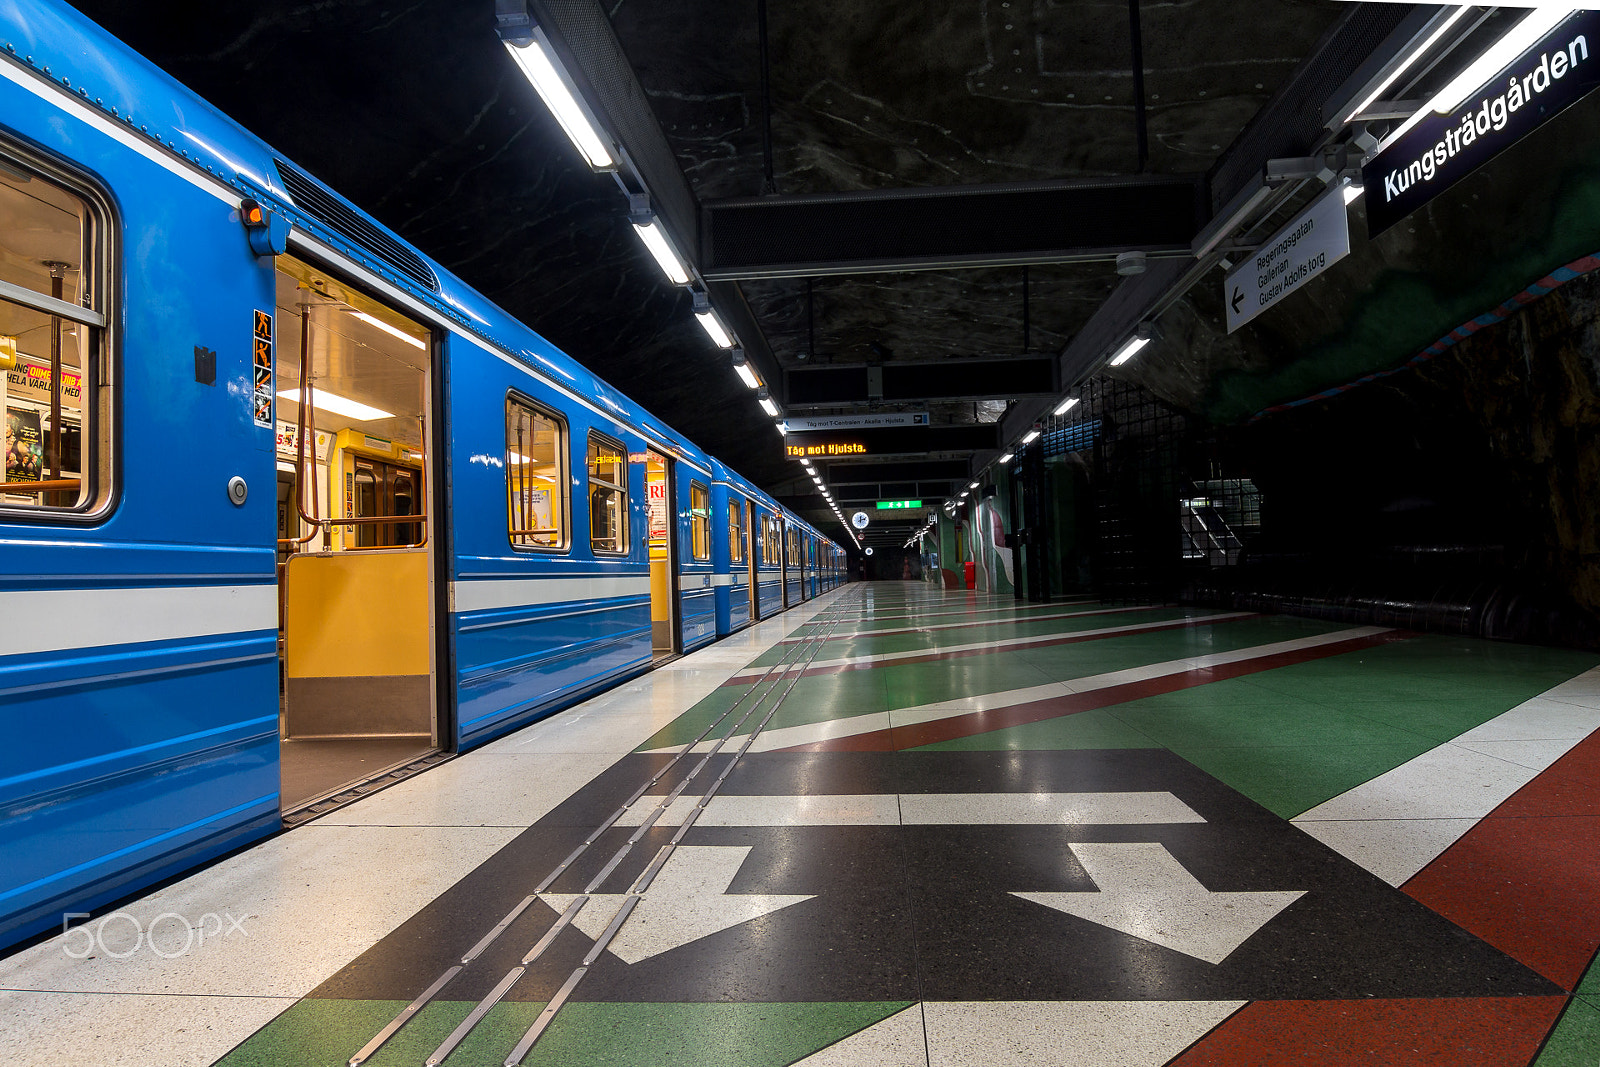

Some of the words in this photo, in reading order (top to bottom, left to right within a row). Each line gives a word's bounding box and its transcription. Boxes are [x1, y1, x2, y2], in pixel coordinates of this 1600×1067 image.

[1384, 34, 1588, 202] Kungsträdgården
[1257, 218, 1314, 271] Regeringsgatan
[1258, 259, 1289, 288] Gallerian
[1259, 281, 1283, 306] Gustav
[1283, 264, 1308, 290] Adolfs
[1308, 252, 1325, 272] torg
[11, 362, 29, 374] ING
[7, 373, 26, 386] HELA
[64, 386, 80, 398] MED
[787, 446, 805, 456] Tåg
[807, 444, 825, 455] mot
[828, 443, 867, 455] Hjulsta.
